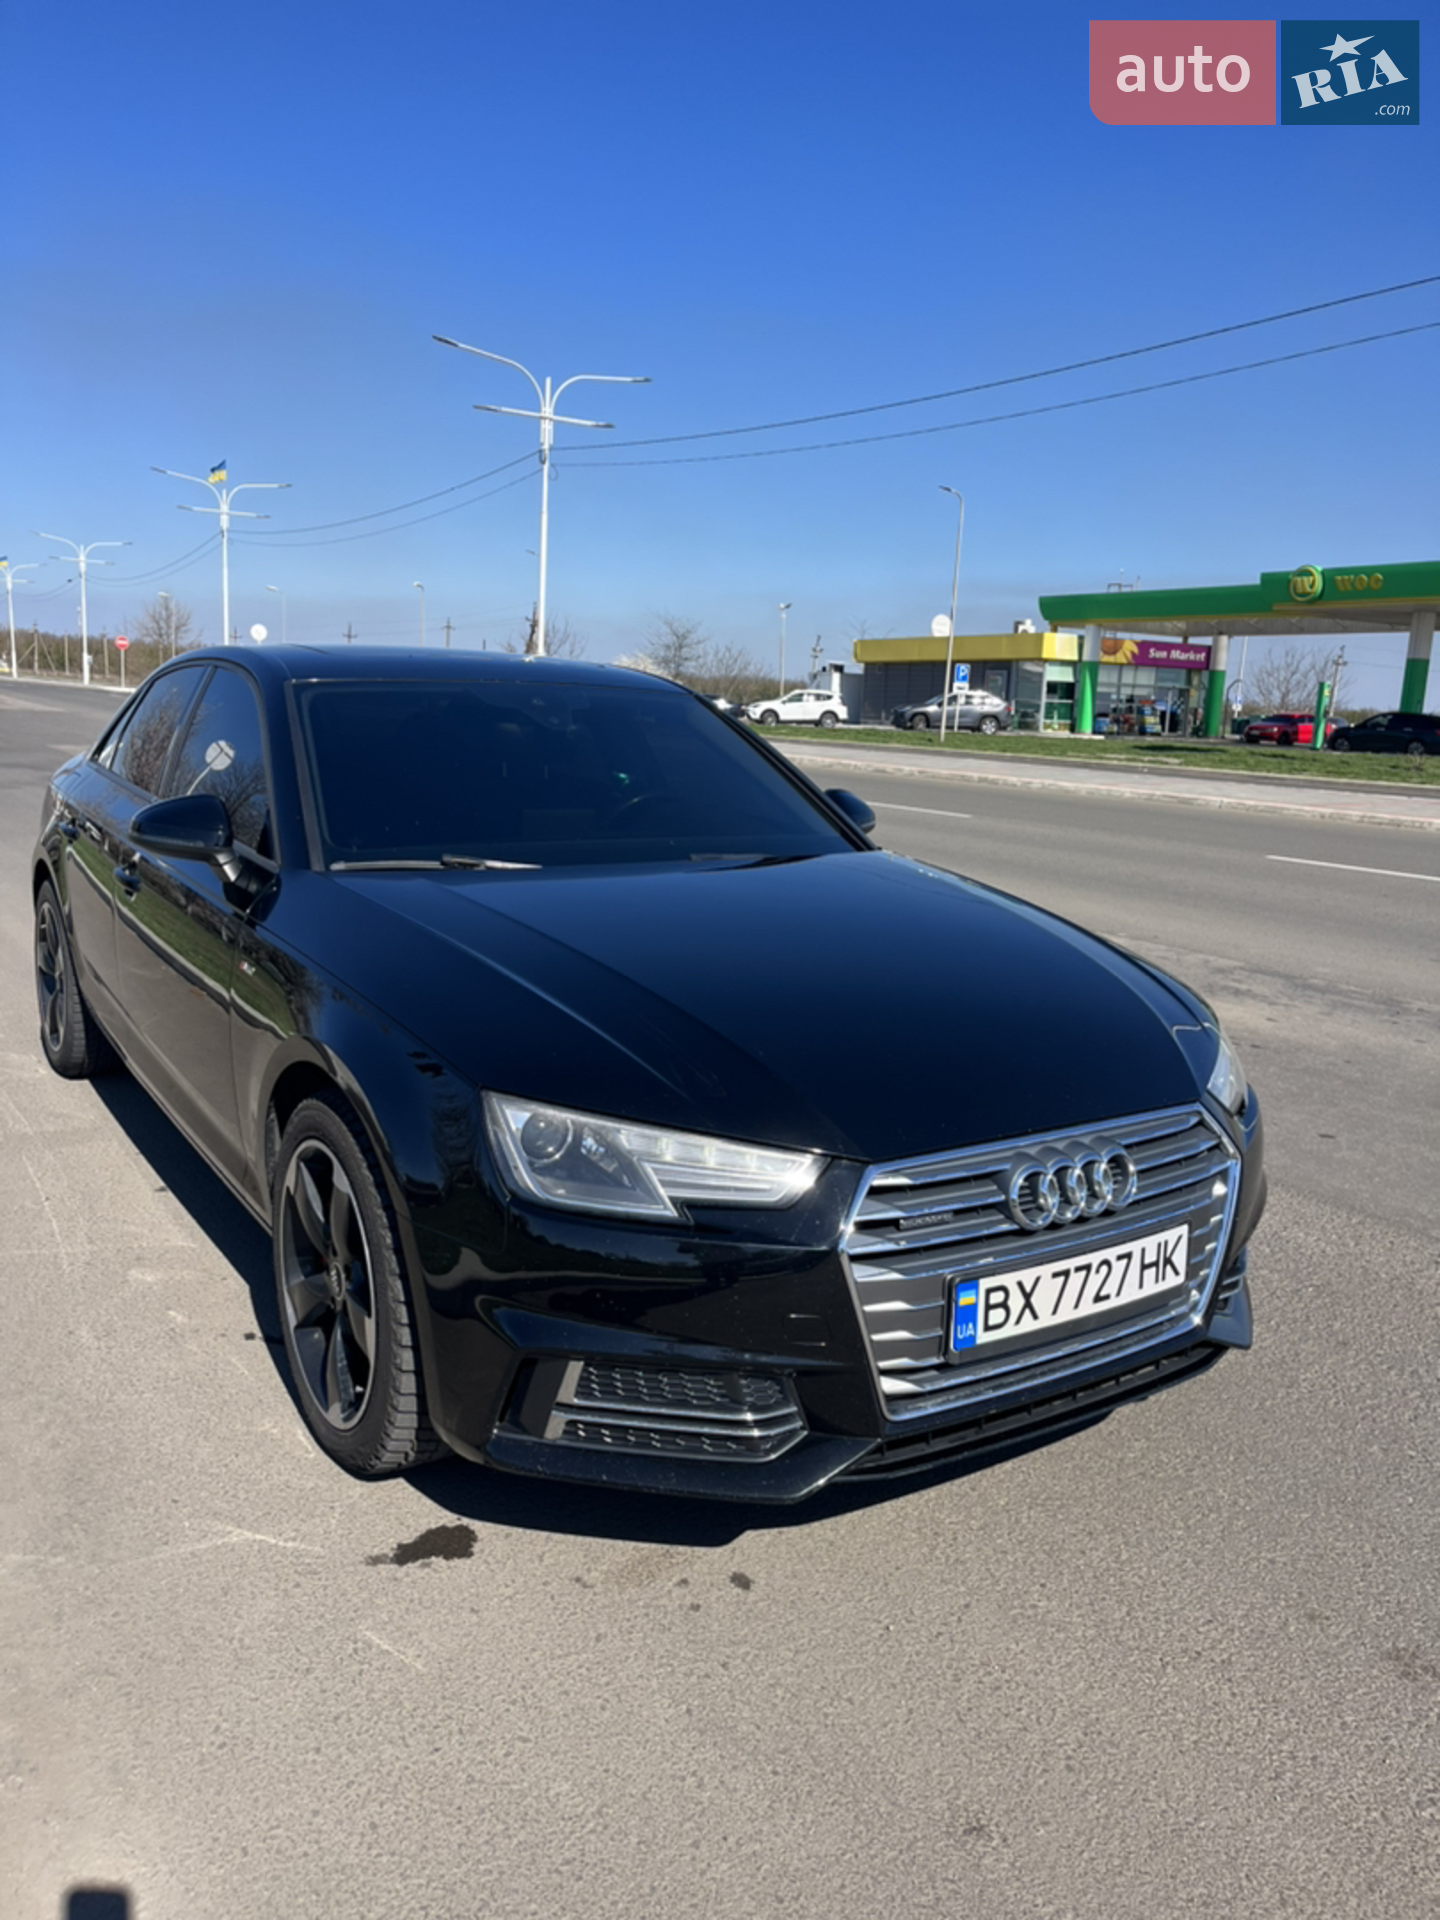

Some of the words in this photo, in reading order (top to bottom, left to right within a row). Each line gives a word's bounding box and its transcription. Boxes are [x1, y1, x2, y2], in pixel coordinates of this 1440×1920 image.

[1148, 647, 1168, 659] Sun
[1169, 649, 1206, 662] Market
[983, 1275, 1042, 1333] BX
[1051, 1251, 1134, 1317] 7727
[1138, 1234, 1184, 1290] HK
[956, 1322, 975, 1340] UA
